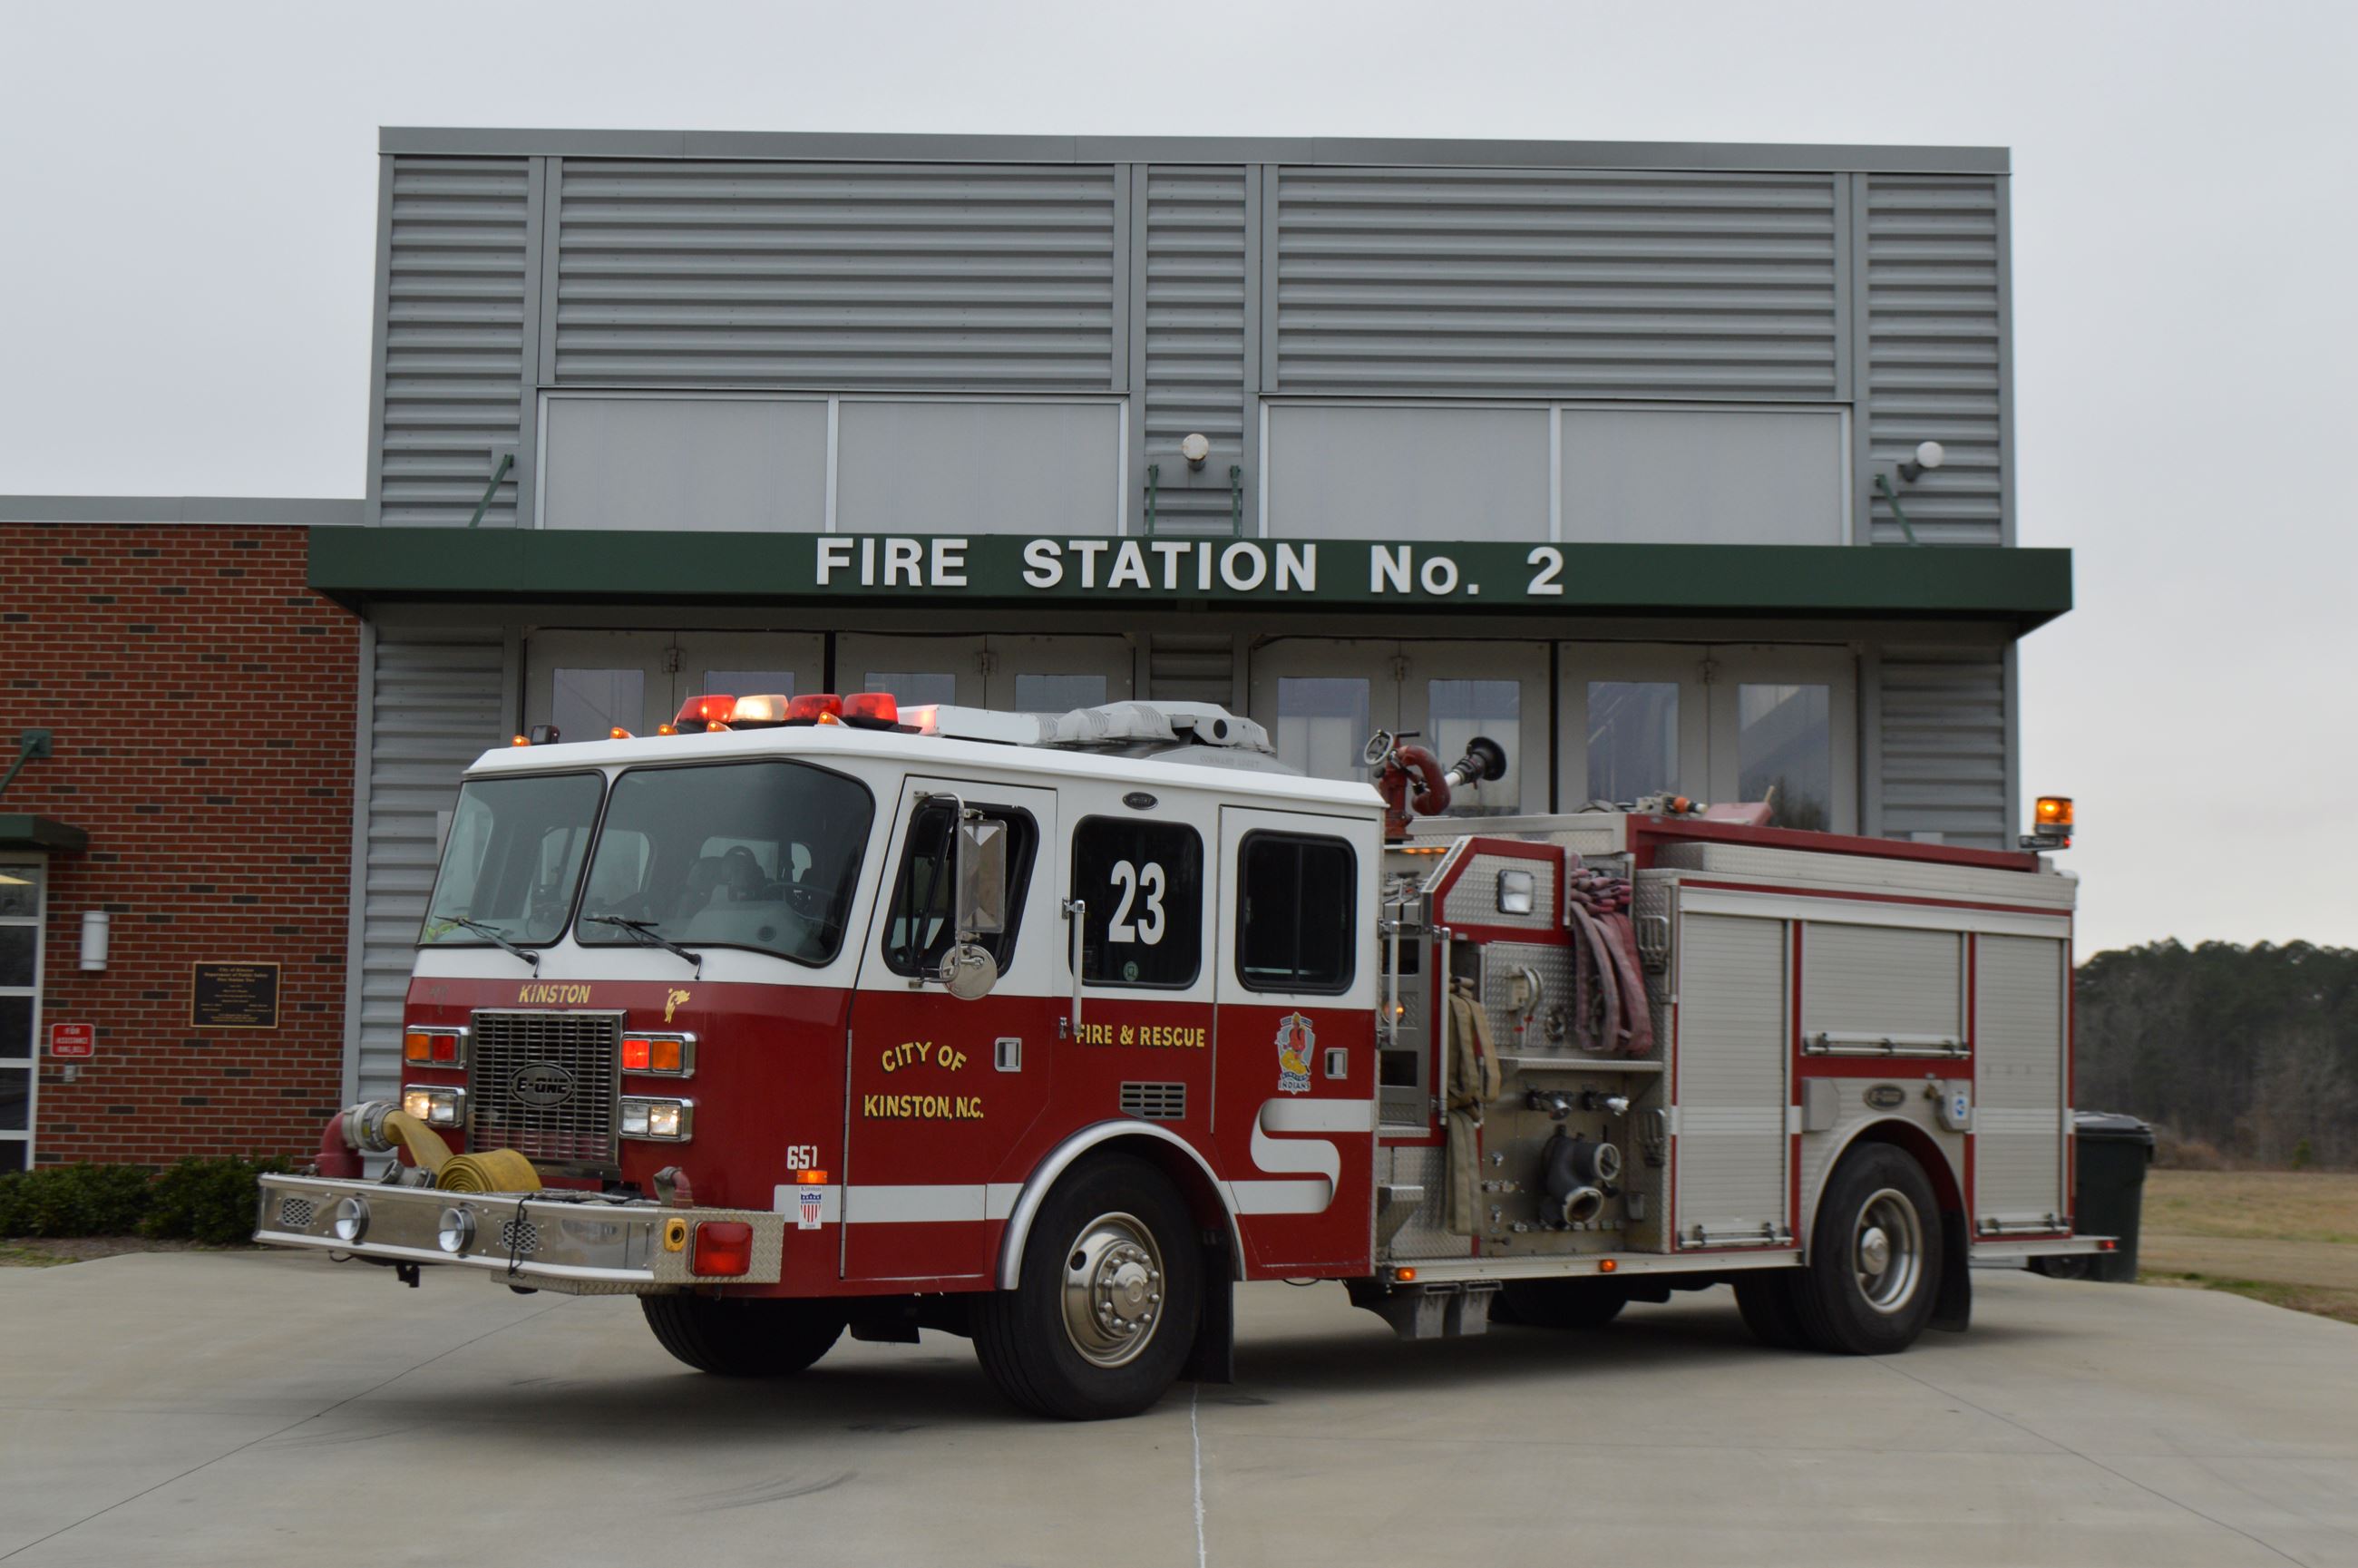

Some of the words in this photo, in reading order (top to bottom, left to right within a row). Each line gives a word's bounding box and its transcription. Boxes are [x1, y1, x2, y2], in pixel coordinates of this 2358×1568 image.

[816, 537, 968, 587] FIRE
[1022, 539, 1316, 591] STATION
[1370, 545, 1479, 595] No.
[1527, 546, 1564, 595] 2
[1108, 860, 1166, 945] 23
[518, 985, 591, 1004] KINSTON
[1076, 1024, 1113, 1045] FIRE
[1119, 1025, 1135, 1046] &
[1140, 1026, 1205, 1047] RESCUE
[882, 1041, 932, 1072] CITY
[938, 1045, 967, 1072] OF
[864, 1095, 953, 1119] KINSTON,
[956, 1096, 984, 1118] N.C.
[786, 1145, 818, 1170] 651
